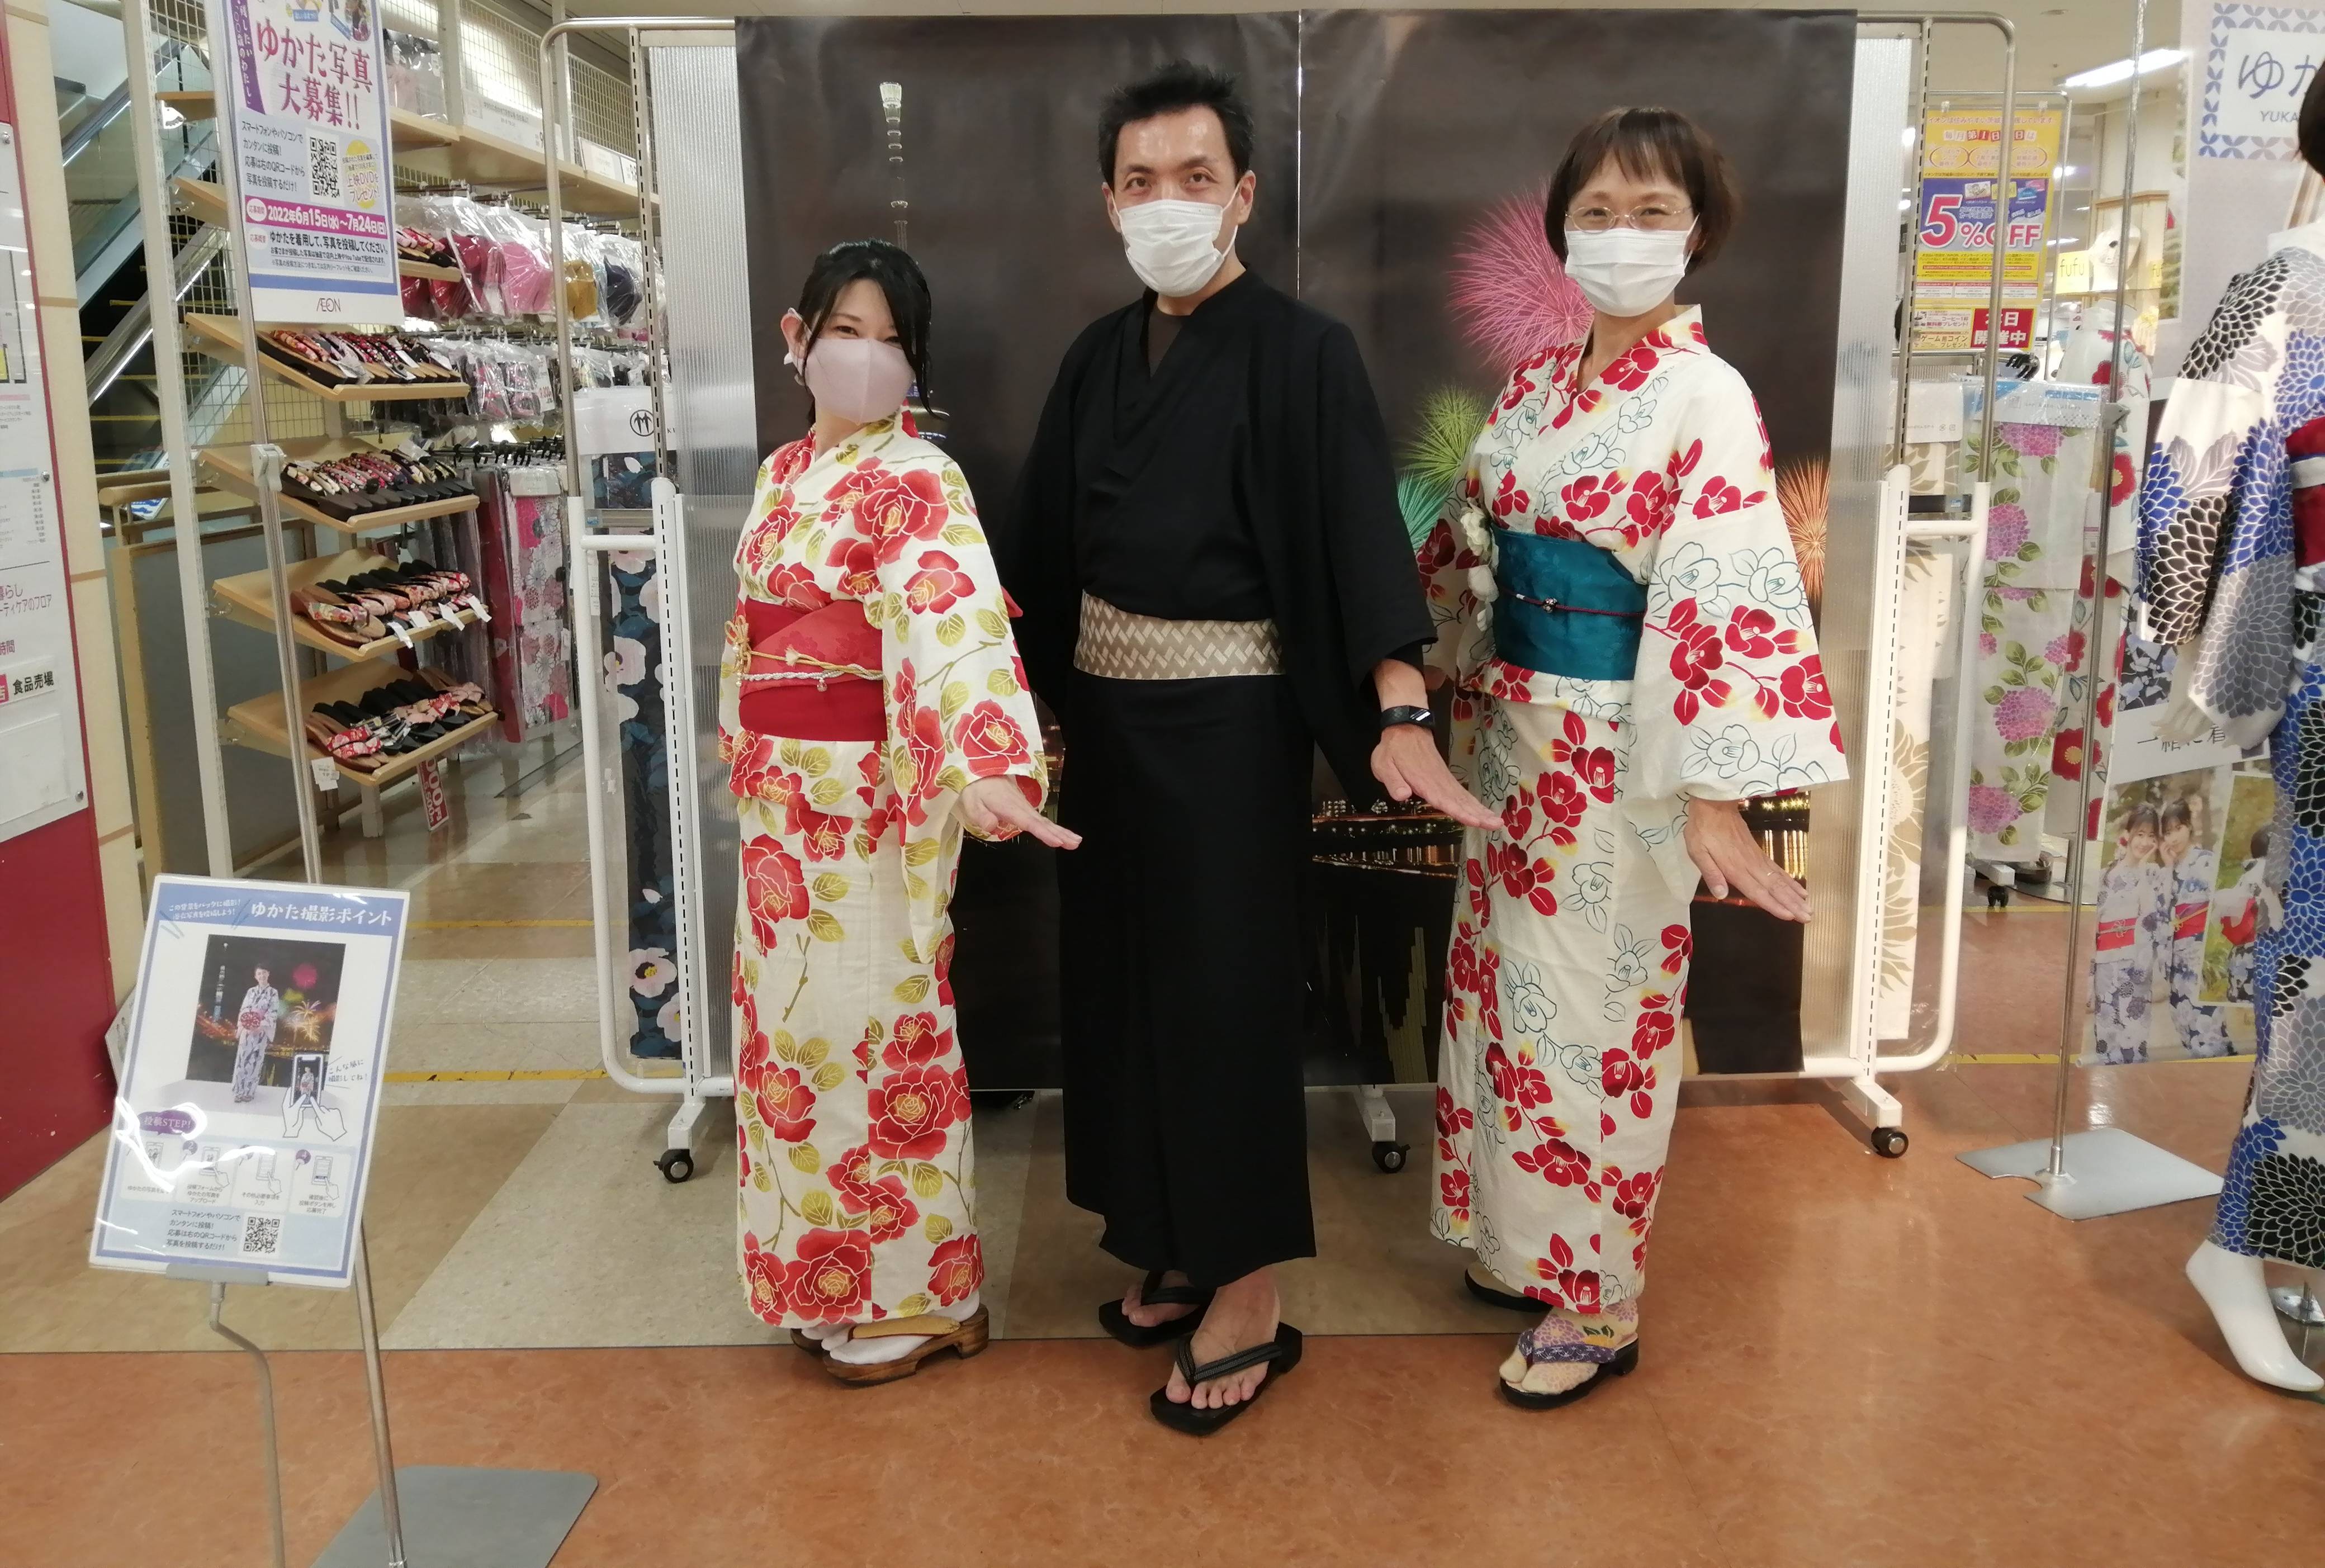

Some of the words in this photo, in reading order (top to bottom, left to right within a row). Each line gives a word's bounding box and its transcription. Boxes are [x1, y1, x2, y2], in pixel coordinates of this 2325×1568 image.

[257, 16, 372, 93] ゆかた写真
[242, 121, 304, 144] スマートフォンやパソコンで
[269, 231, 389, 254] ゆかたを着用して、写真を投稿してください。
[13, 671, 54, 695] 食品売場
[252, 901, 392, 926] ゆかた撮影ポイント
[172, 1210, 241, 1221] スマートフォンやパソコンで
[168, 1229, 237, 1242] 応募は右のQRコードから
